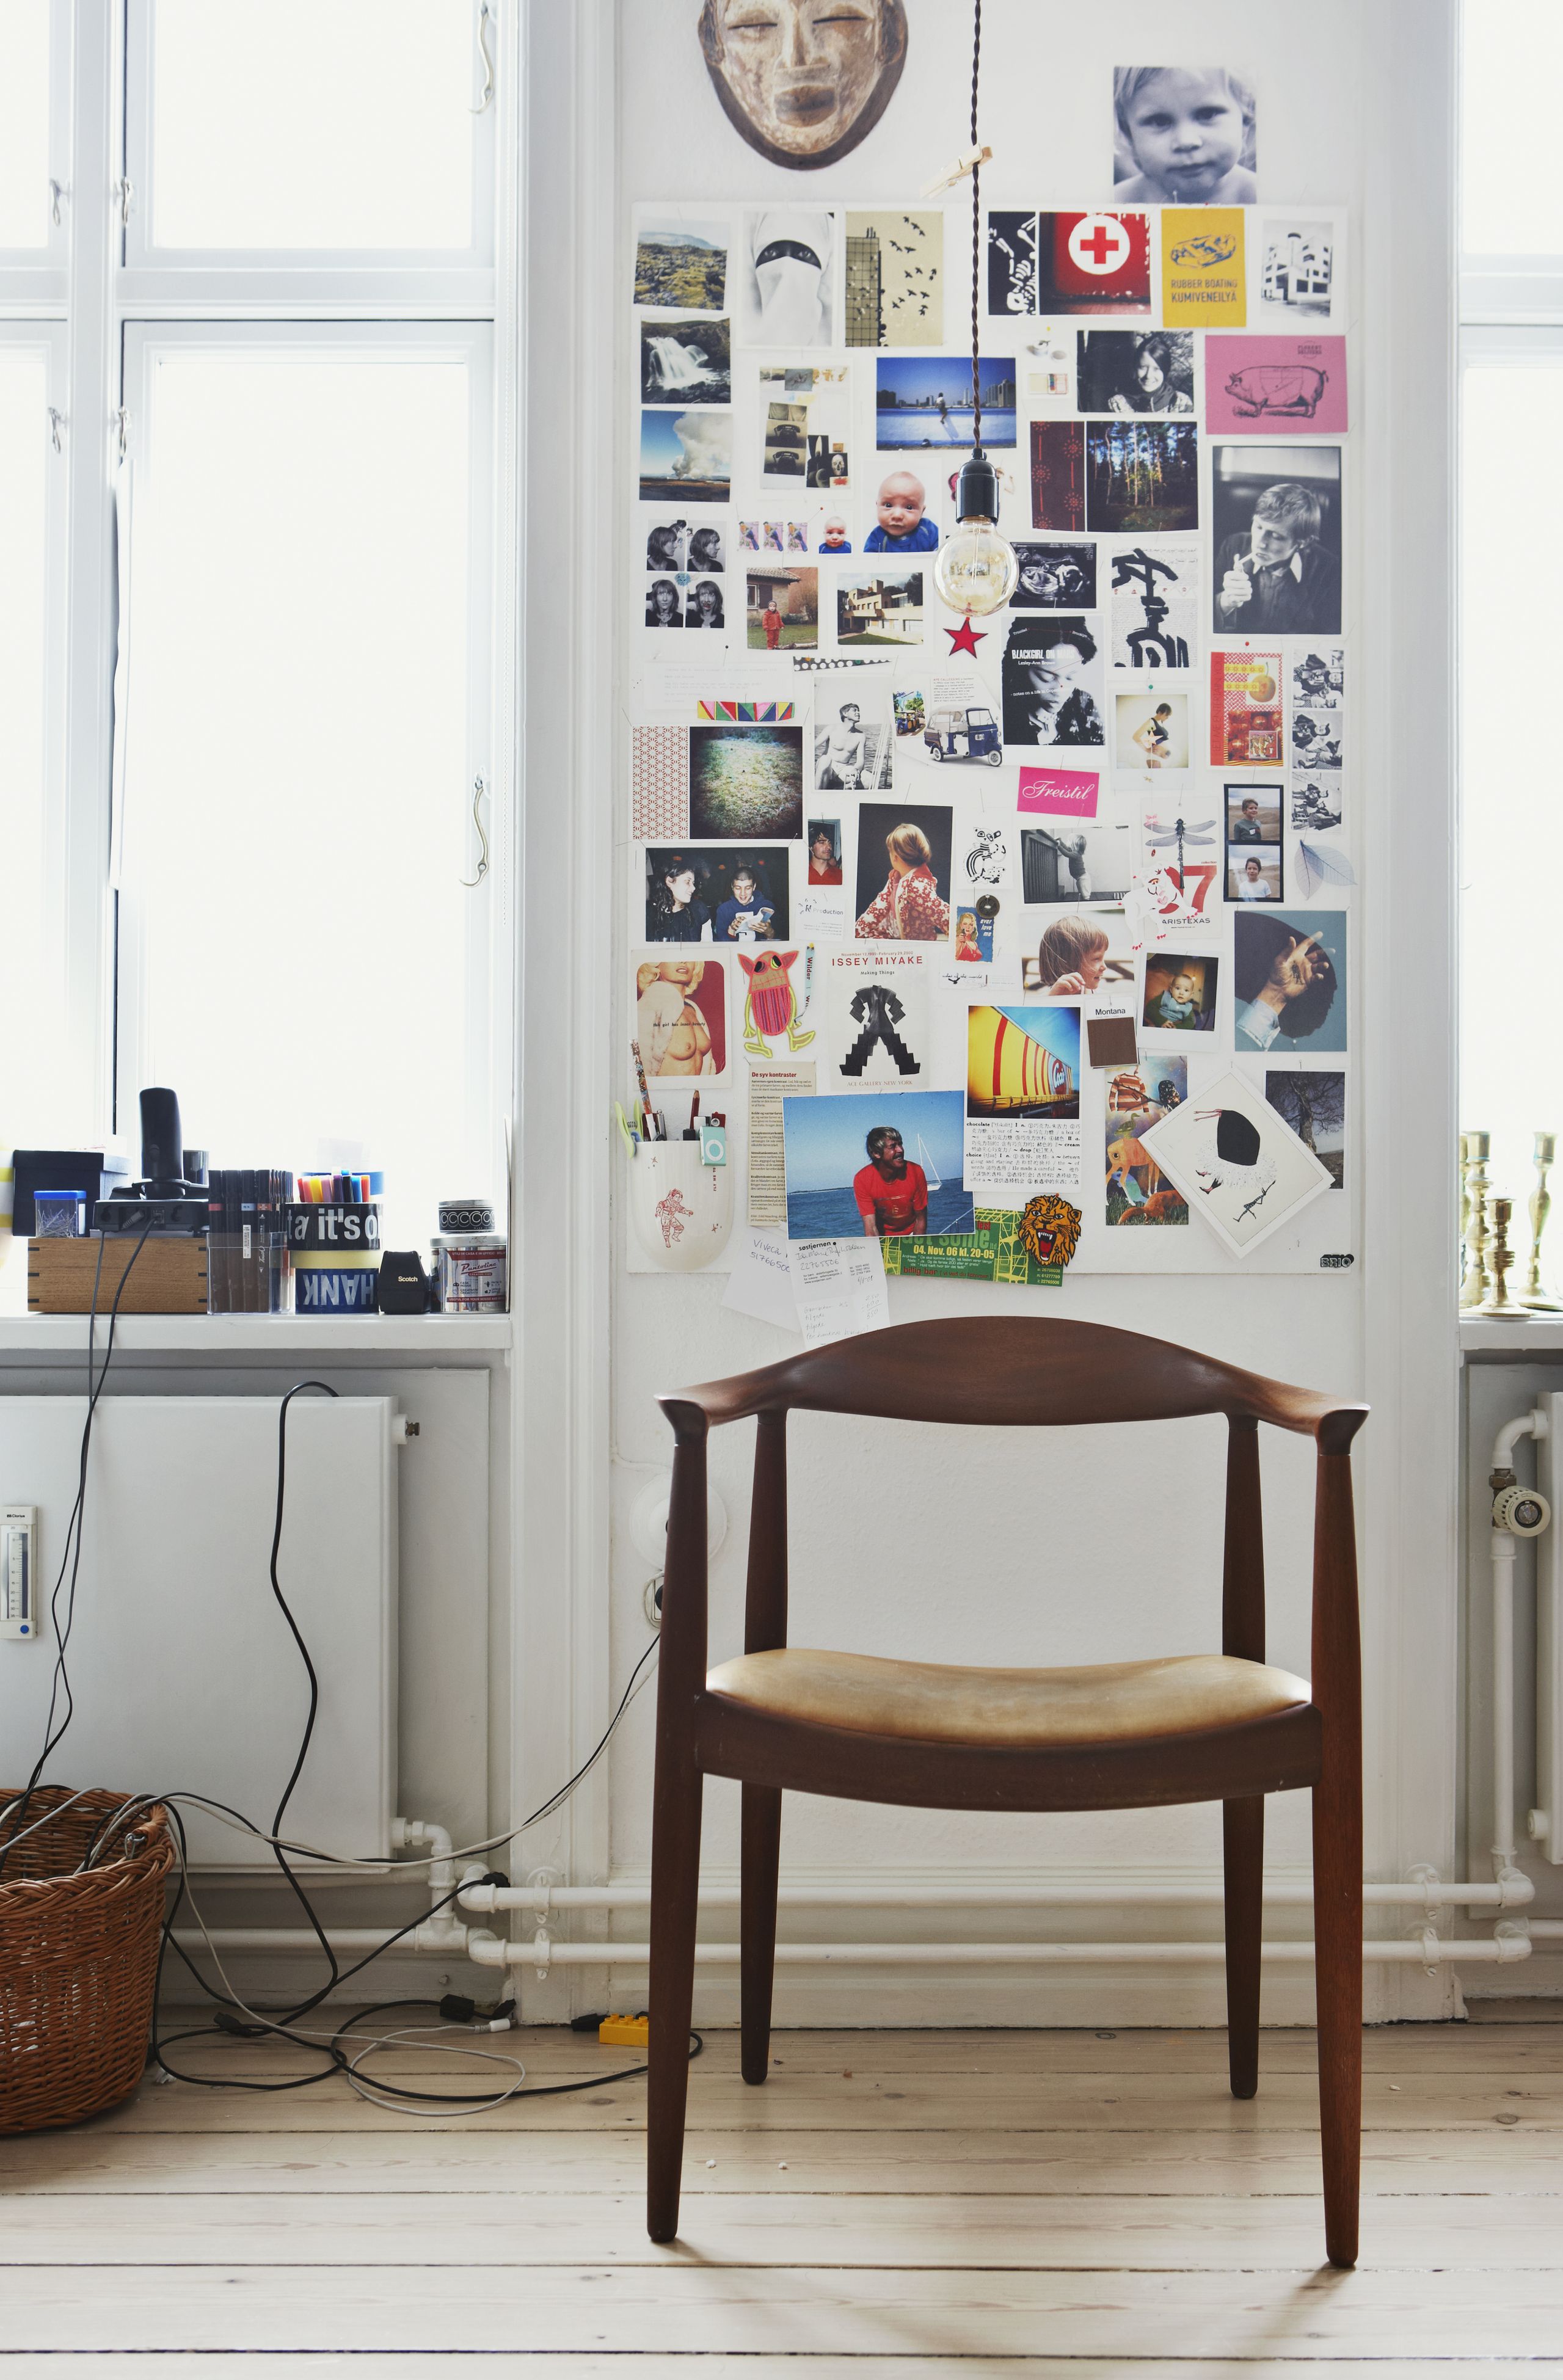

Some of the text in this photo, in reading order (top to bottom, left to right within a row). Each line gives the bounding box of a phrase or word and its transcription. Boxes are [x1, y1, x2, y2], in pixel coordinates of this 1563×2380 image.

[1171, 279, 1237, 288] RUBBER BOATING
[1171, 290, 1237, 302] KUMIVENEILYÄ
[1011, 649, 1044, 659] BLACKGIRL
[1046, 649, 1055, 659] ON
[1022, 781, 1095, 799] Freistil
[875, 956, 923, 965] MIYAKE
[318, 1208, 360, 1240] it's
[914, 1245, 994, 1259] 04. Nov. 06 kl. 20-05
[1320, 1254, 1354, 1268] BRIO
[903, 1267, 921, 1276] billig
[303, 1275, 374, 1305] HANK
